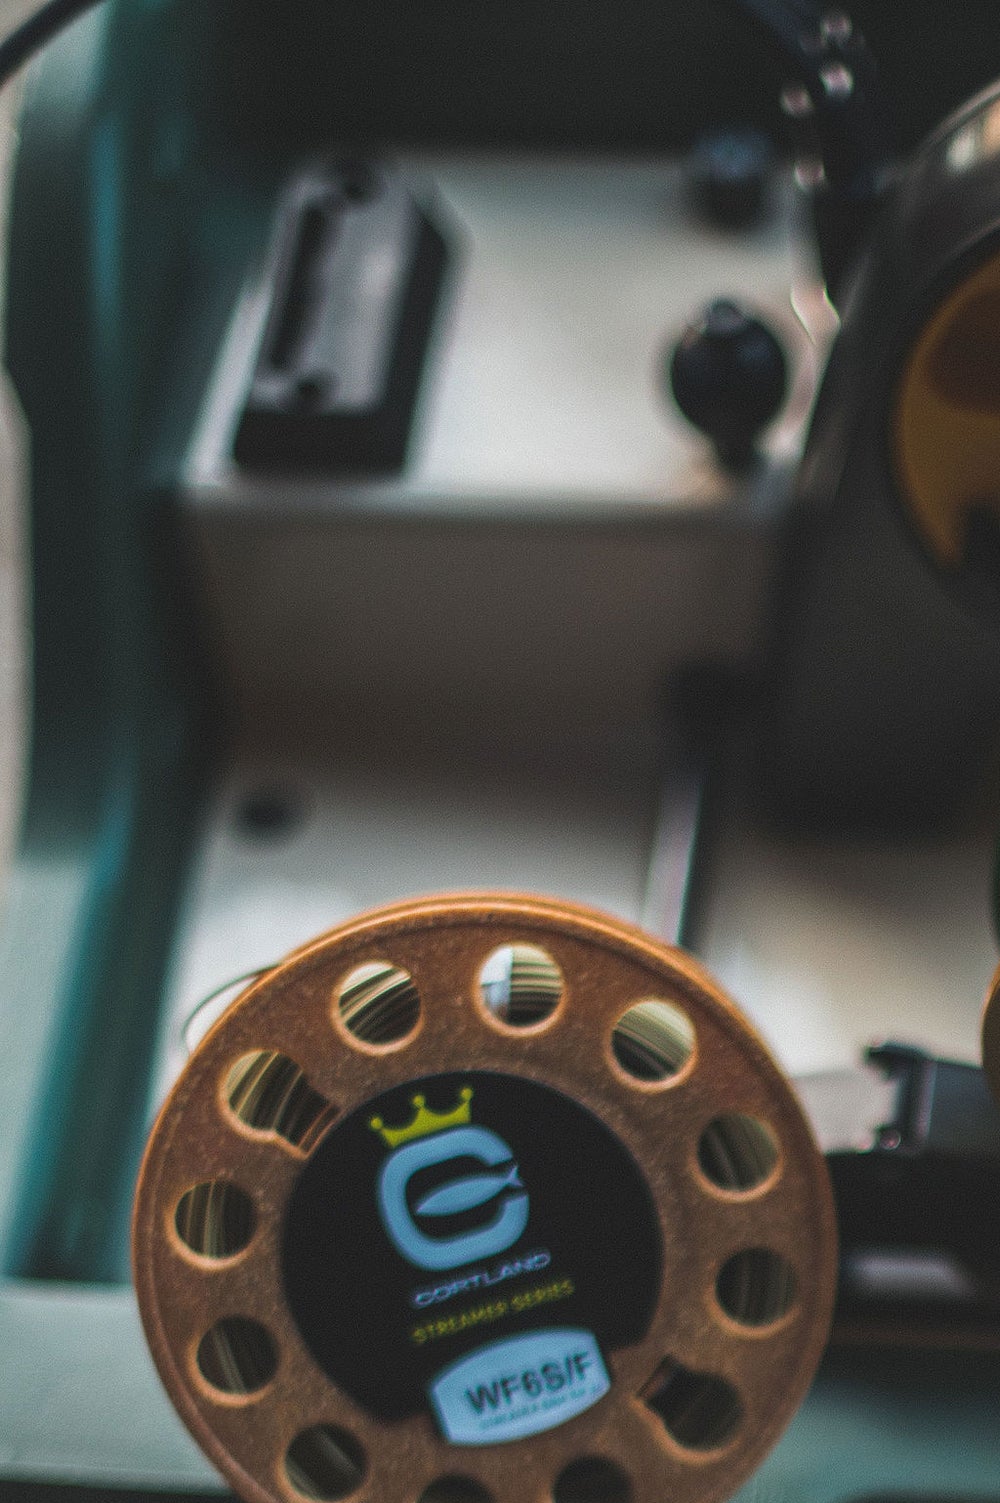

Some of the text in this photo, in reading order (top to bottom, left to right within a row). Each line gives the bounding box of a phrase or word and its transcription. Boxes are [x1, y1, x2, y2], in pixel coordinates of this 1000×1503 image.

[413, 1251, 550, 1306] CORTLAND
[412, 1279, 574, 1343] STREAMER SERIES
[465, 1351, 592, 1414] WF6S/F
